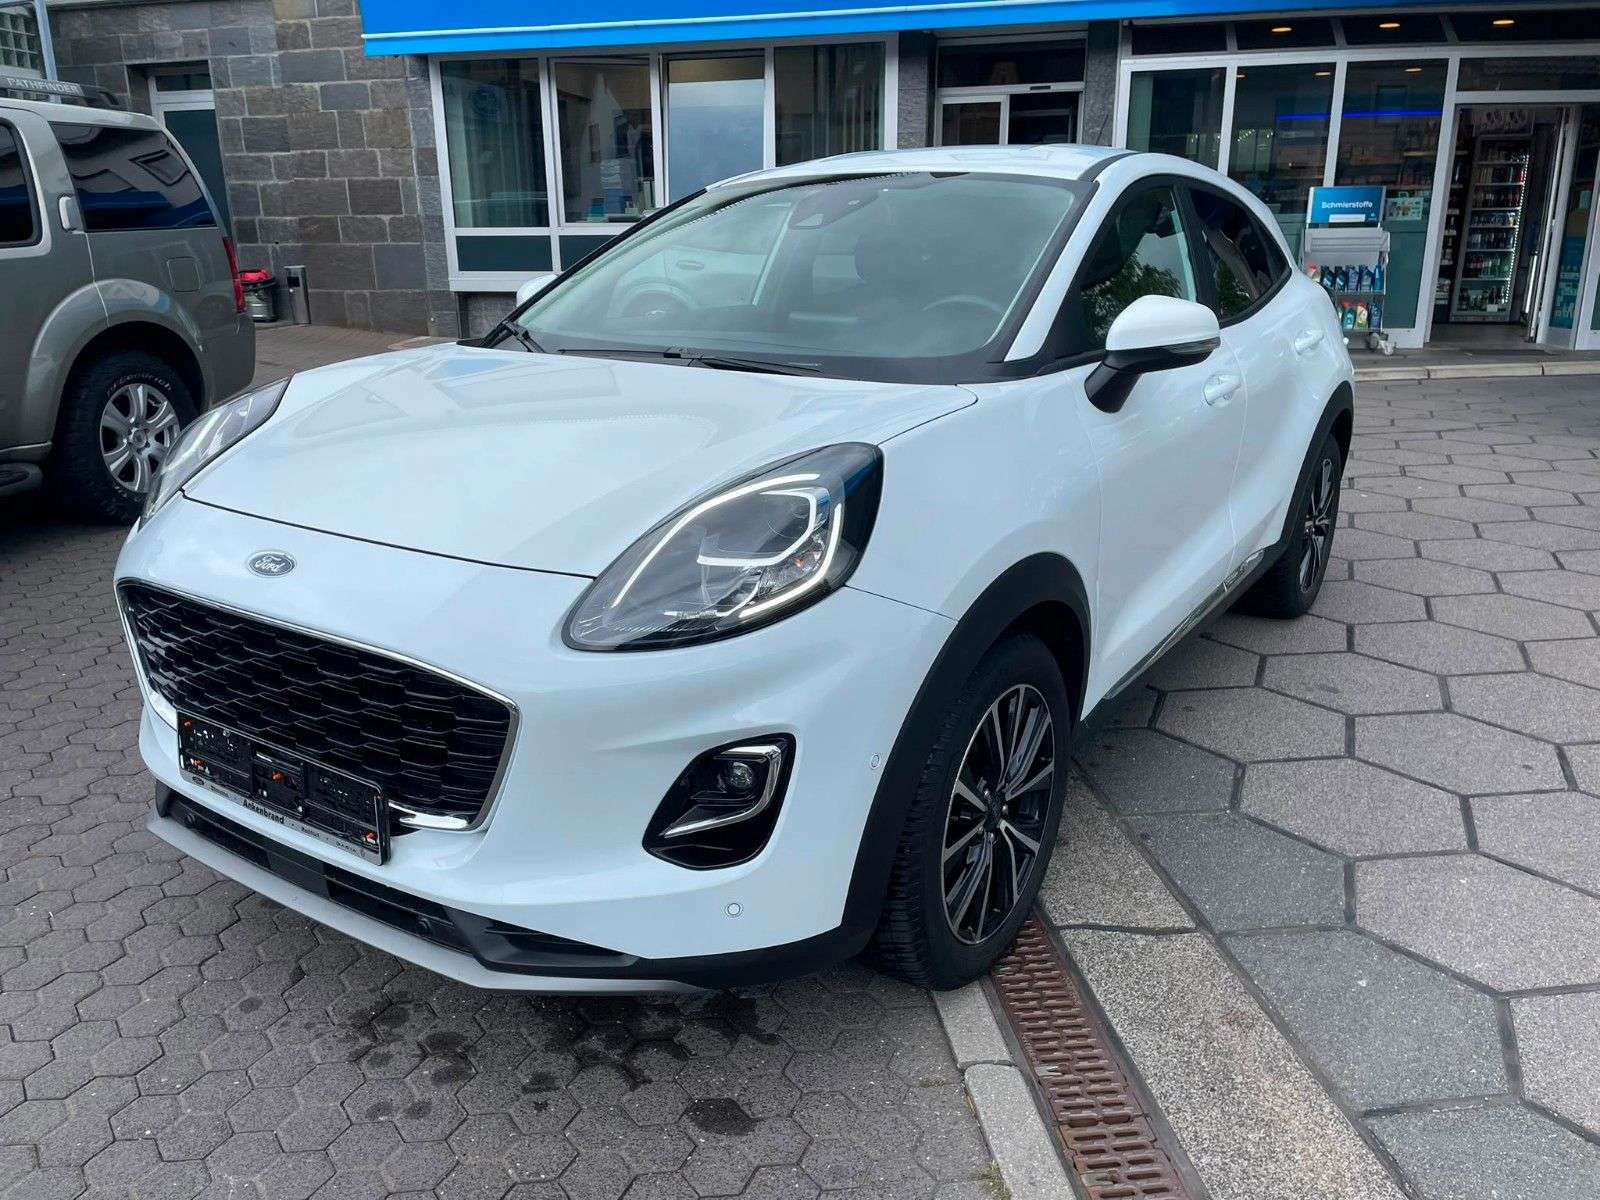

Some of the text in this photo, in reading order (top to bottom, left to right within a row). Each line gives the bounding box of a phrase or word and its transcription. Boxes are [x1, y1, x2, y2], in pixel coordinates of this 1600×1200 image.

[6, 78, 82, 96] PATHFINDER
[1321, 200, 1373, 209] Schmierstoffe
[254, 555, 285, 572] Ford
[242, 799, 285, 824] Ankenbrand
